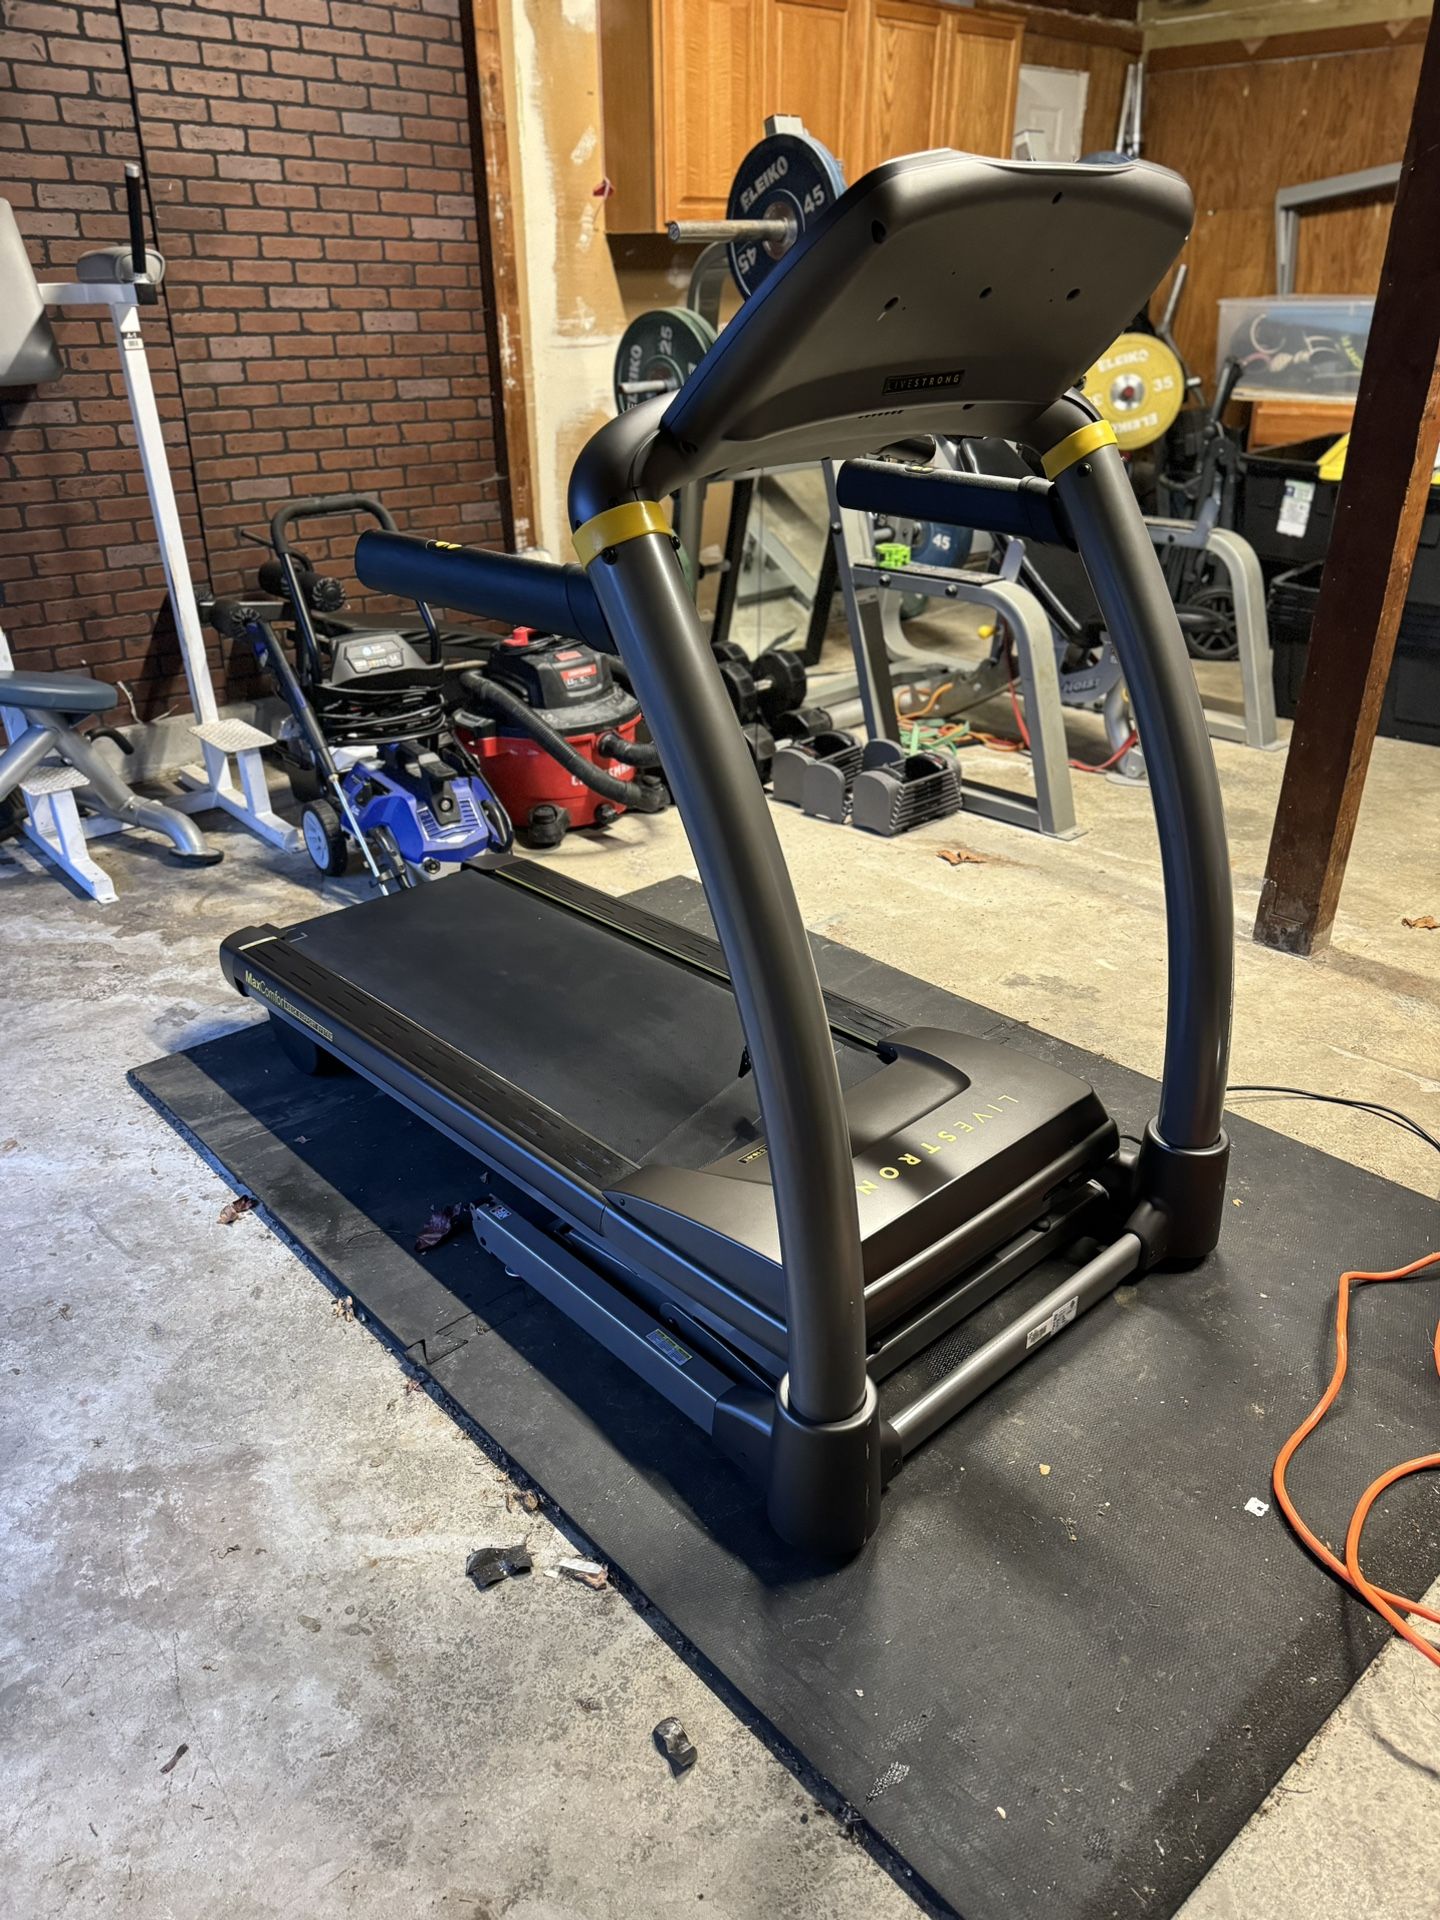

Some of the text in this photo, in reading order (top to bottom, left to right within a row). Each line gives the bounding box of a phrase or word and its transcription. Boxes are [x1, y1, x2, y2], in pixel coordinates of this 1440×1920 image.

[740, 156, 788, 214] ELEIKO
[804, 184, 825, 214] 45
[738, 247, 757, 274] 45
[660, 325, 673, 356] 25
[887, 374, 960, 391] LIVESTRONG
[1153, 375, 1174, 393] 35
[932, 533, 951, 551] 45
[856, 1094, 1019, 1195] LIVESTRON
